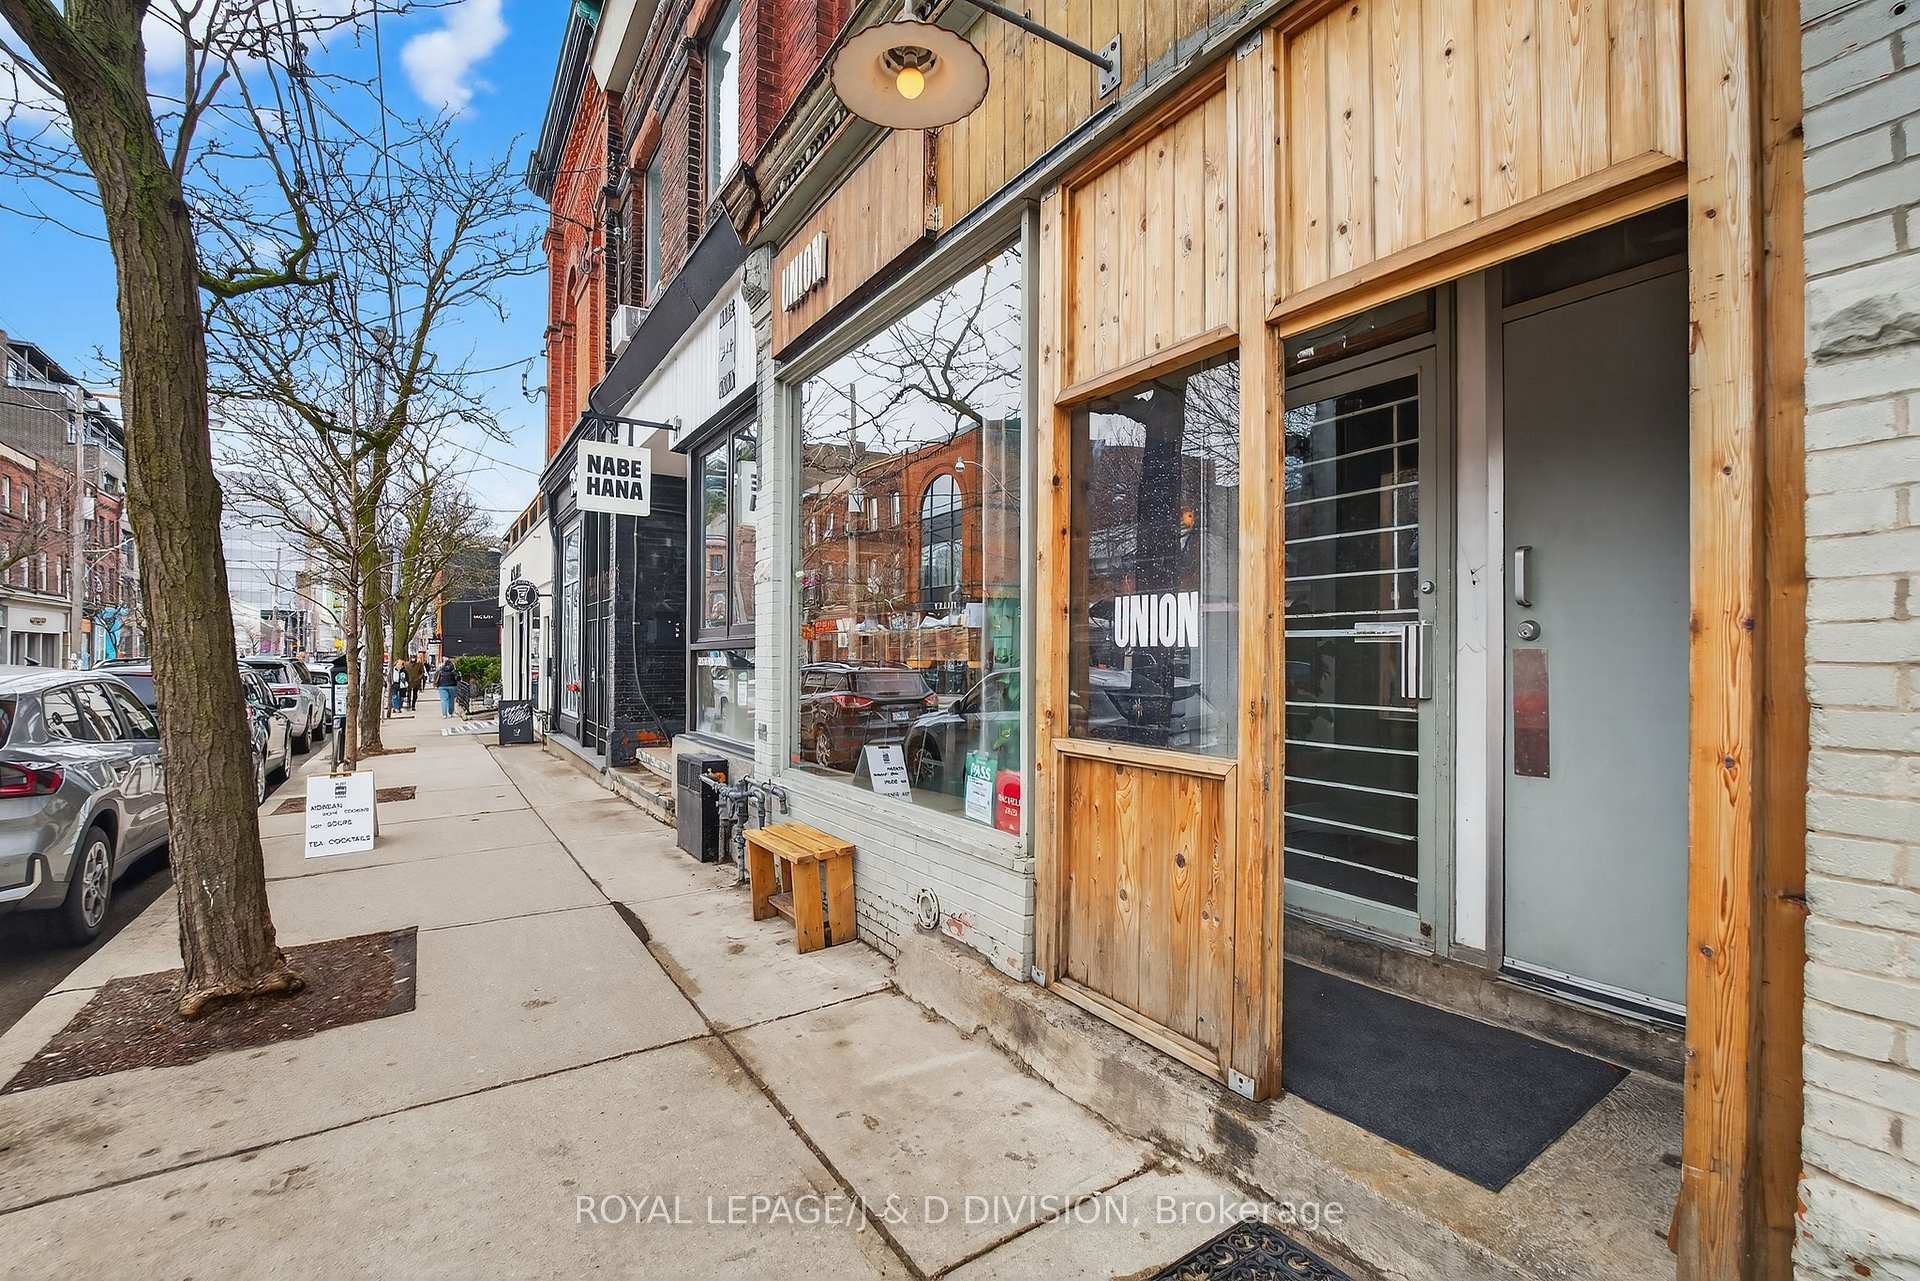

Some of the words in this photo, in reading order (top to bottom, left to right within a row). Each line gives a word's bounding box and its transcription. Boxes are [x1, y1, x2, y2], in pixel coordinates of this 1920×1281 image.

[782, 231, 828, 312] UNION
[587, 454, 642, 479] NABE
[586, 476, 644, 501] HANA
[1114, 591, 1199, 648] UNION
[971, 763, 991, 781] PASS
[328, 835, 370, 844] COCKTAILS
